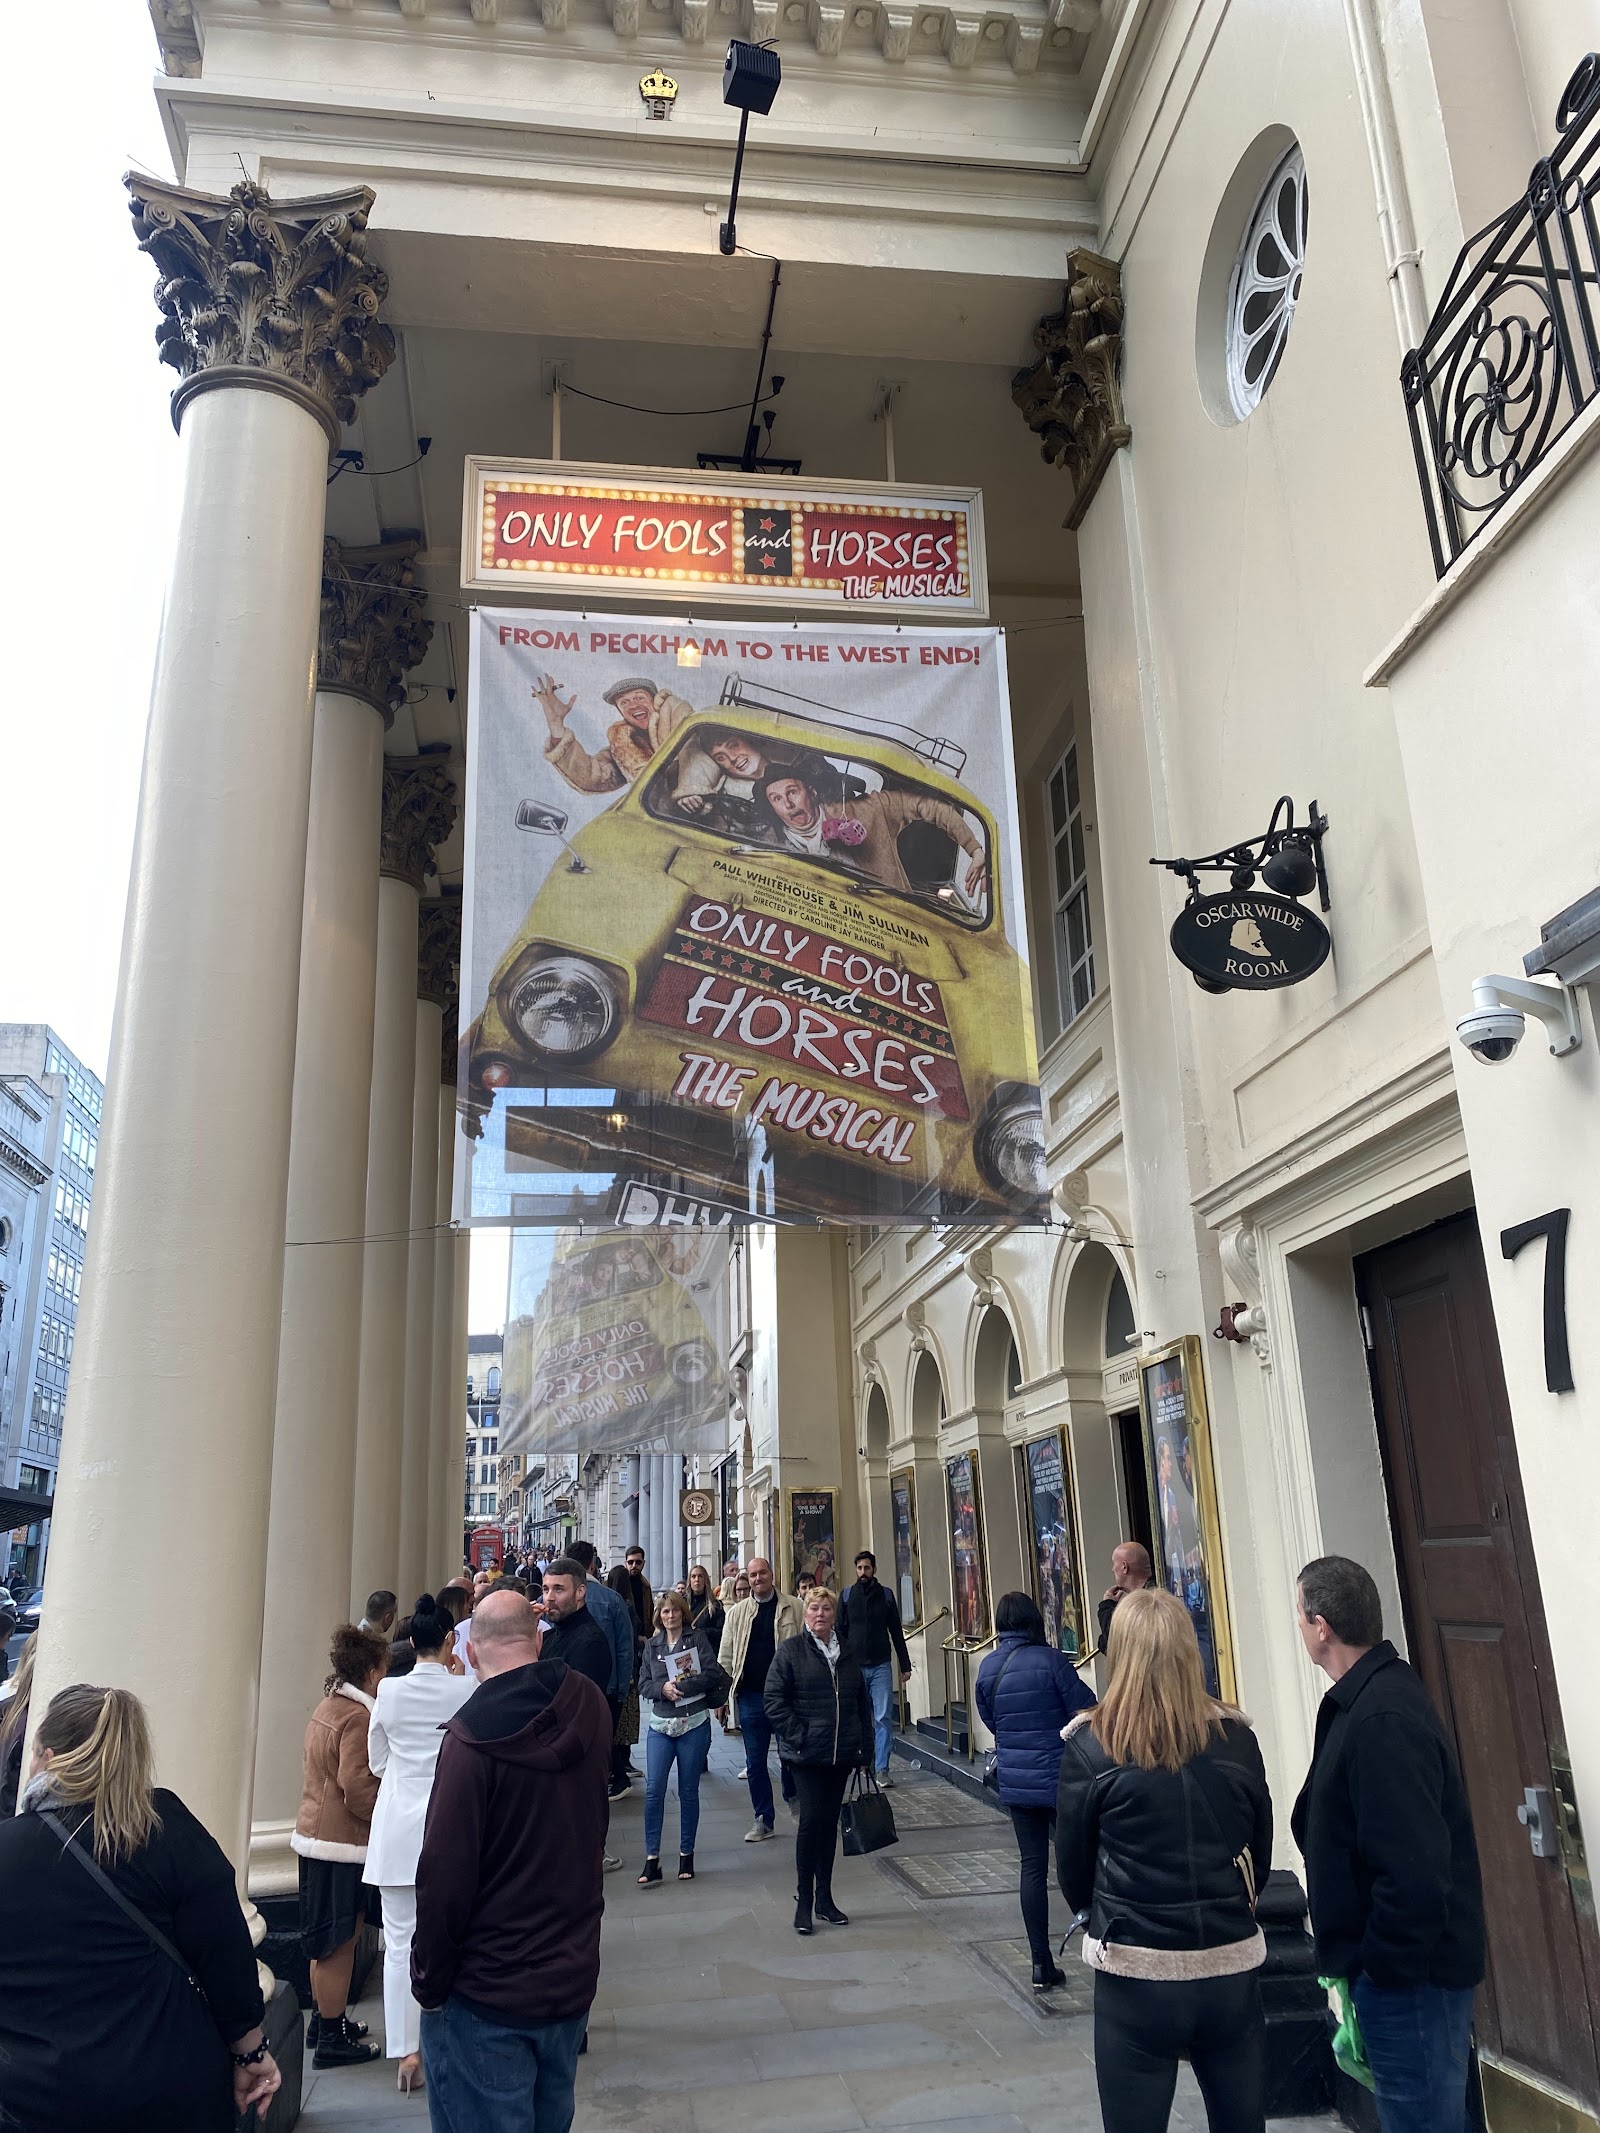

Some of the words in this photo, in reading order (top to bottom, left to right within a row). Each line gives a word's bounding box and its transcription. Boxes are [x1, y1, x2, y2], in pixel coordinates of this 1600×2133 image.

[501, 510, 604, 551] ONLY
[612, 515, 728, 557] FOOLS
[744, 528, 791, 549] and
[809, 529, 955, 572] HORSES
[843, 574, 882, 600] THE
[882, 571, 968, 599] MUSICAL
[498, 626, 581, 652] FROM
[590, 630, 729, 659] PECKHAM
[736, 640, 773, 660] TO
[781, 643, 830, 663] THE
[836, 645, 909, 665] WEST
[919, 645, 982, 667] END!
[712, 860, 742, 876] PAUL
[746, 870, 824, 906] WHITEHOUSE
[828, 900, 838, 911] &
[843, 905, 864, 921] JIM
[868, 914, 930, 948] SULLIVAN
[724, 872, 738, 882] BASED
[748, 880, 756, 888] THE
[801, 900, 817, 910] FOOLS
[818, 906, 829, 914] AND
[880, 930, 894, 939] JOHN
[753, 895, 787, 913] DIRECTED
[788, 907, 798, 917] BY
[800, 912, 837, 932] CAROLINE
[838, 926, 852, 938] JAY
[854, 933, 886, 951] RANGER
[754, 890, 782, 903] ADDITIONAL
[783, 899, 797, 908] MUSIC
[806, 907, 820, 917] JOHN
[820, 913, 843, 926] SULLIVAN
[849, 924, 863, 933] CHAS
[1195, 902, 1254, 928] OSCAR
[1254, 904, 1305, 932] WILDE
[689, 902, 810, 962] ONLY
[819, 945, 937, 1014] FOOLS
[1224, 958, 1290, 978] ROOM
[781, 977, 863, 1015] and
[685, 976, 940, 1104] HORSES
[674, 1052, 758, 1109] THE
[752, 1077, 917, 1165] MUSICAL
[1500, 1208, 1575, 1395] 7
